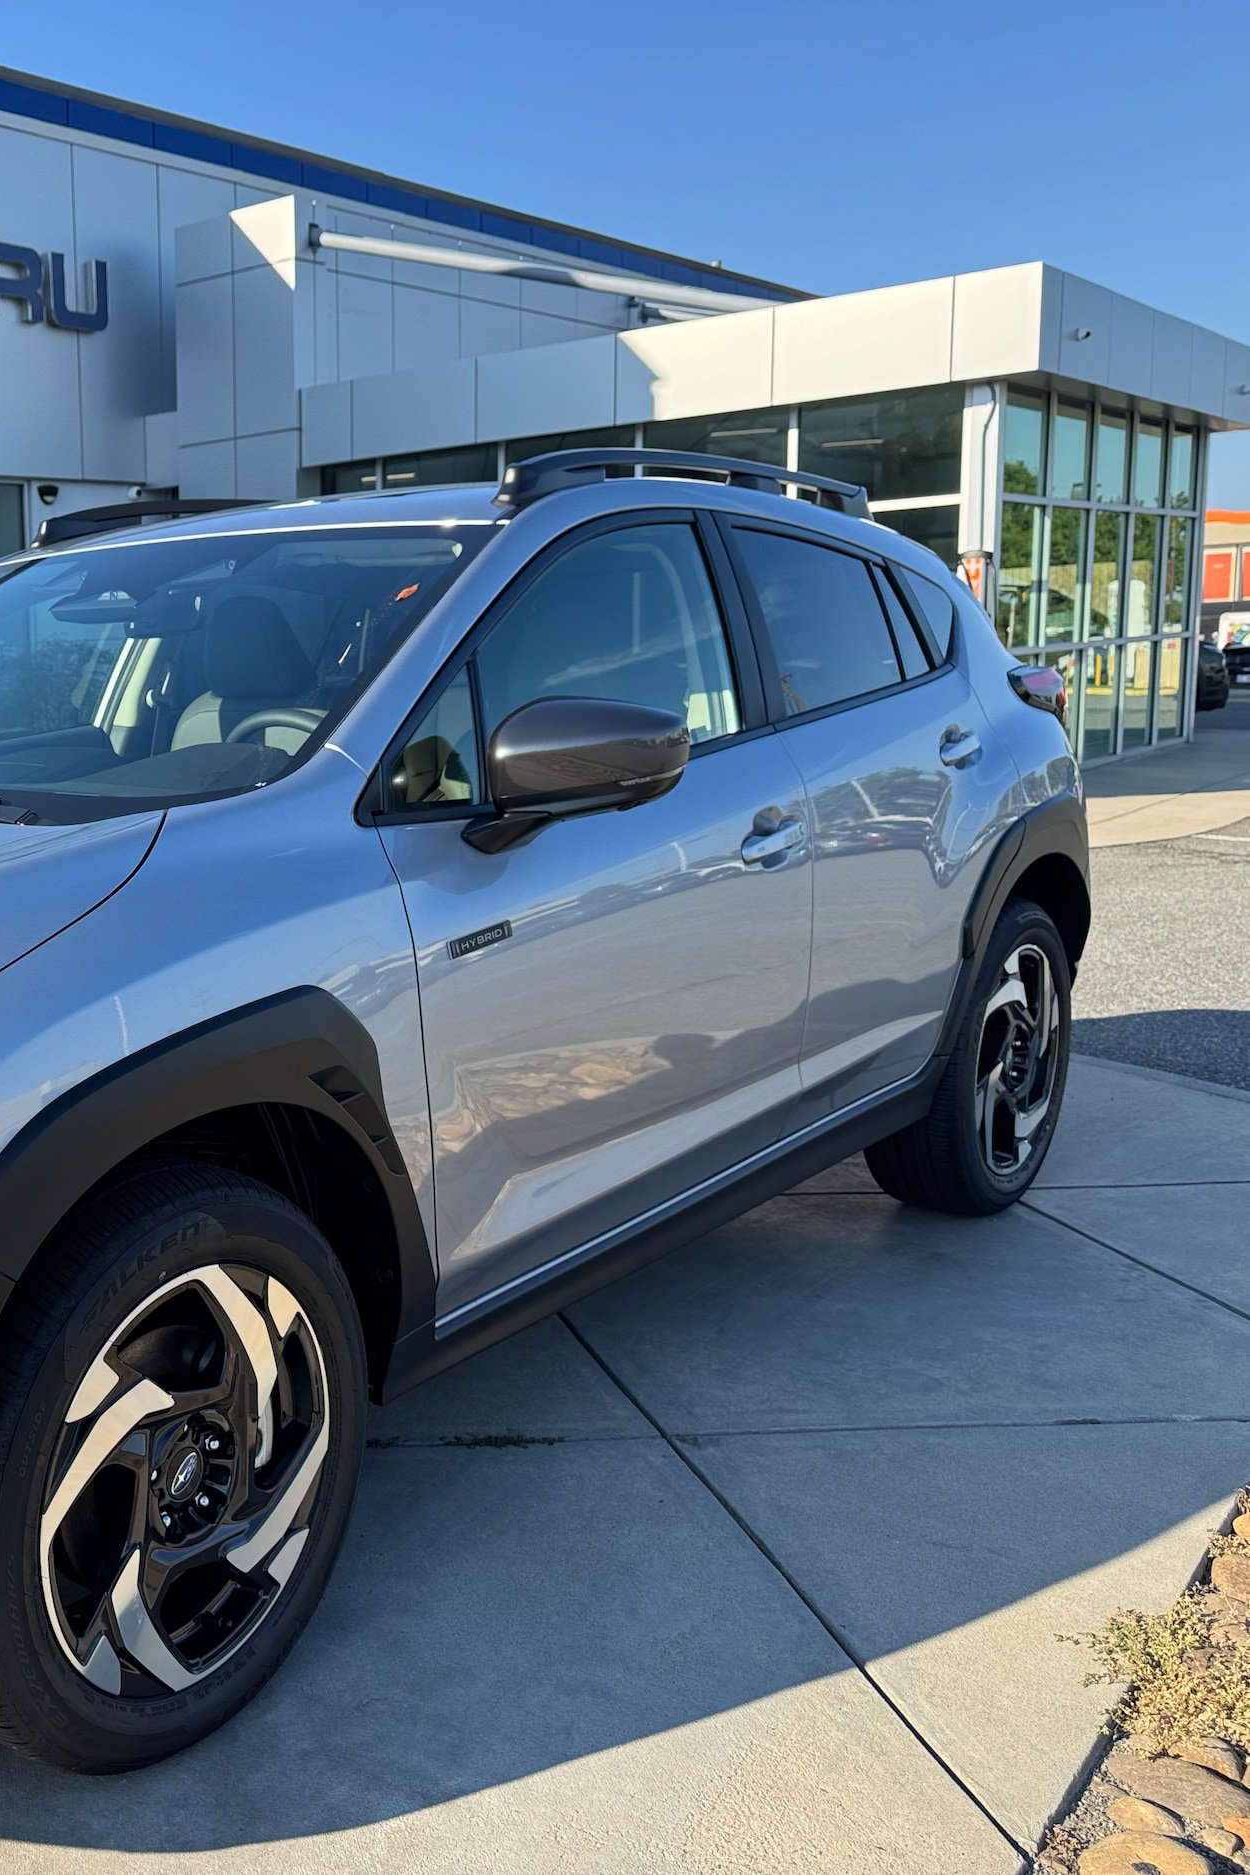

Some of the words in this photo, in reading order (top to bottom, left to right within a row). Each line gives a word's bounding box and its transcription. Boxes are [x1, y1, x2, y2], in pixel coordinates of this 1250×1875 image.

[461, 929, 502, 950] HYBRID
[81, 1221, 202, 1333] FALKEN
[19, 1399, 47, 1477] OUTSIDE
